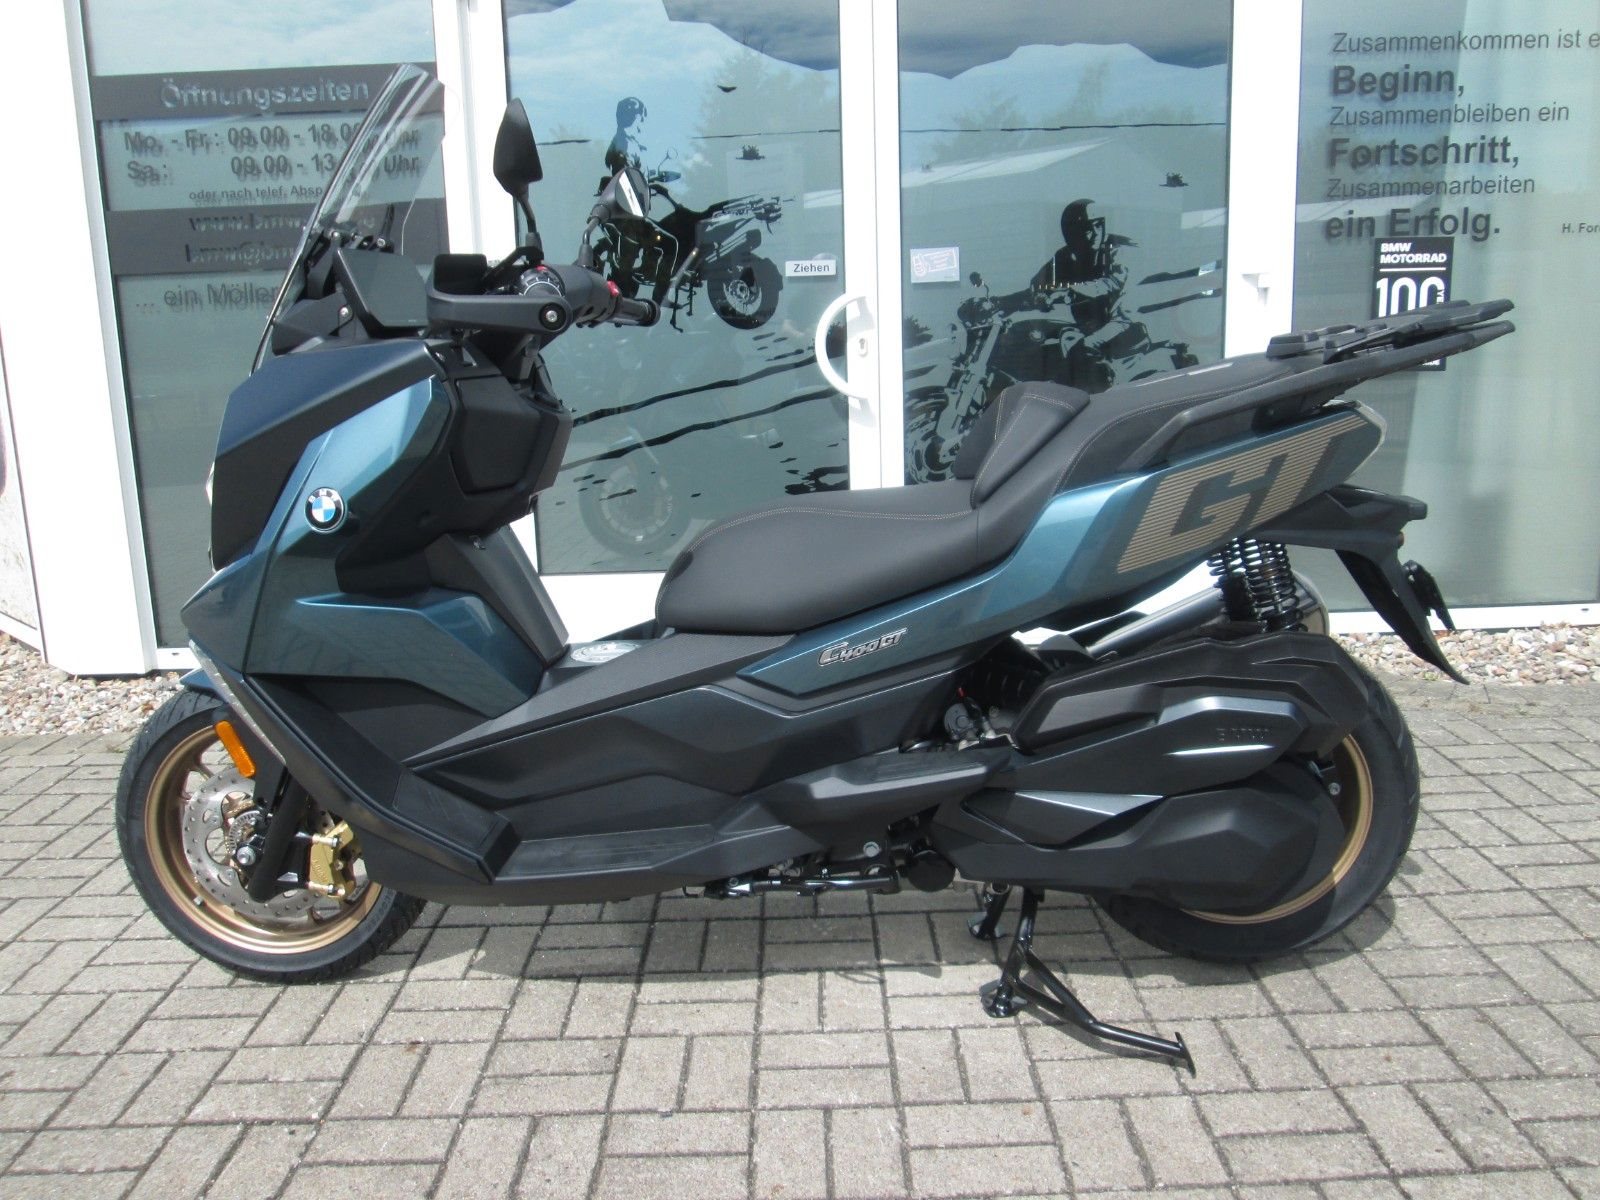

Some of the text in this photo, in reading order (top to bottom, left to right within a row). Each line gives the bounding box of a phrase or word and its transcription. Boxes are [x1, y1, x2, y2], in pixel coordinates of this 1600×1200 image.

[1332, 31, 1549, 53] Zusammenkommen
[1557, 28, 1581, 49] ist
[1332, 63, 1465, 101] Beginn,
[1330, 102, 1570, 126] Zusammenbleiben ein
[1329, 135, 1519, 169] Fortschritt,
[188, 189, 217, 201] oder
[221, 187, 252, 200] nach
[1327, 176, 1535, 198] Zusammenarbeiten
[1325, 206, 1500, 241] ein Erfolg.
[1561, 222, 1575, 233] H.
[1379, 253, 1447, 264] MOTORRAD
[1380, 243, 1412, 253] BMW
[793, 263, 830, 273] Ziehen
[164, 284, 200, 307] ein
